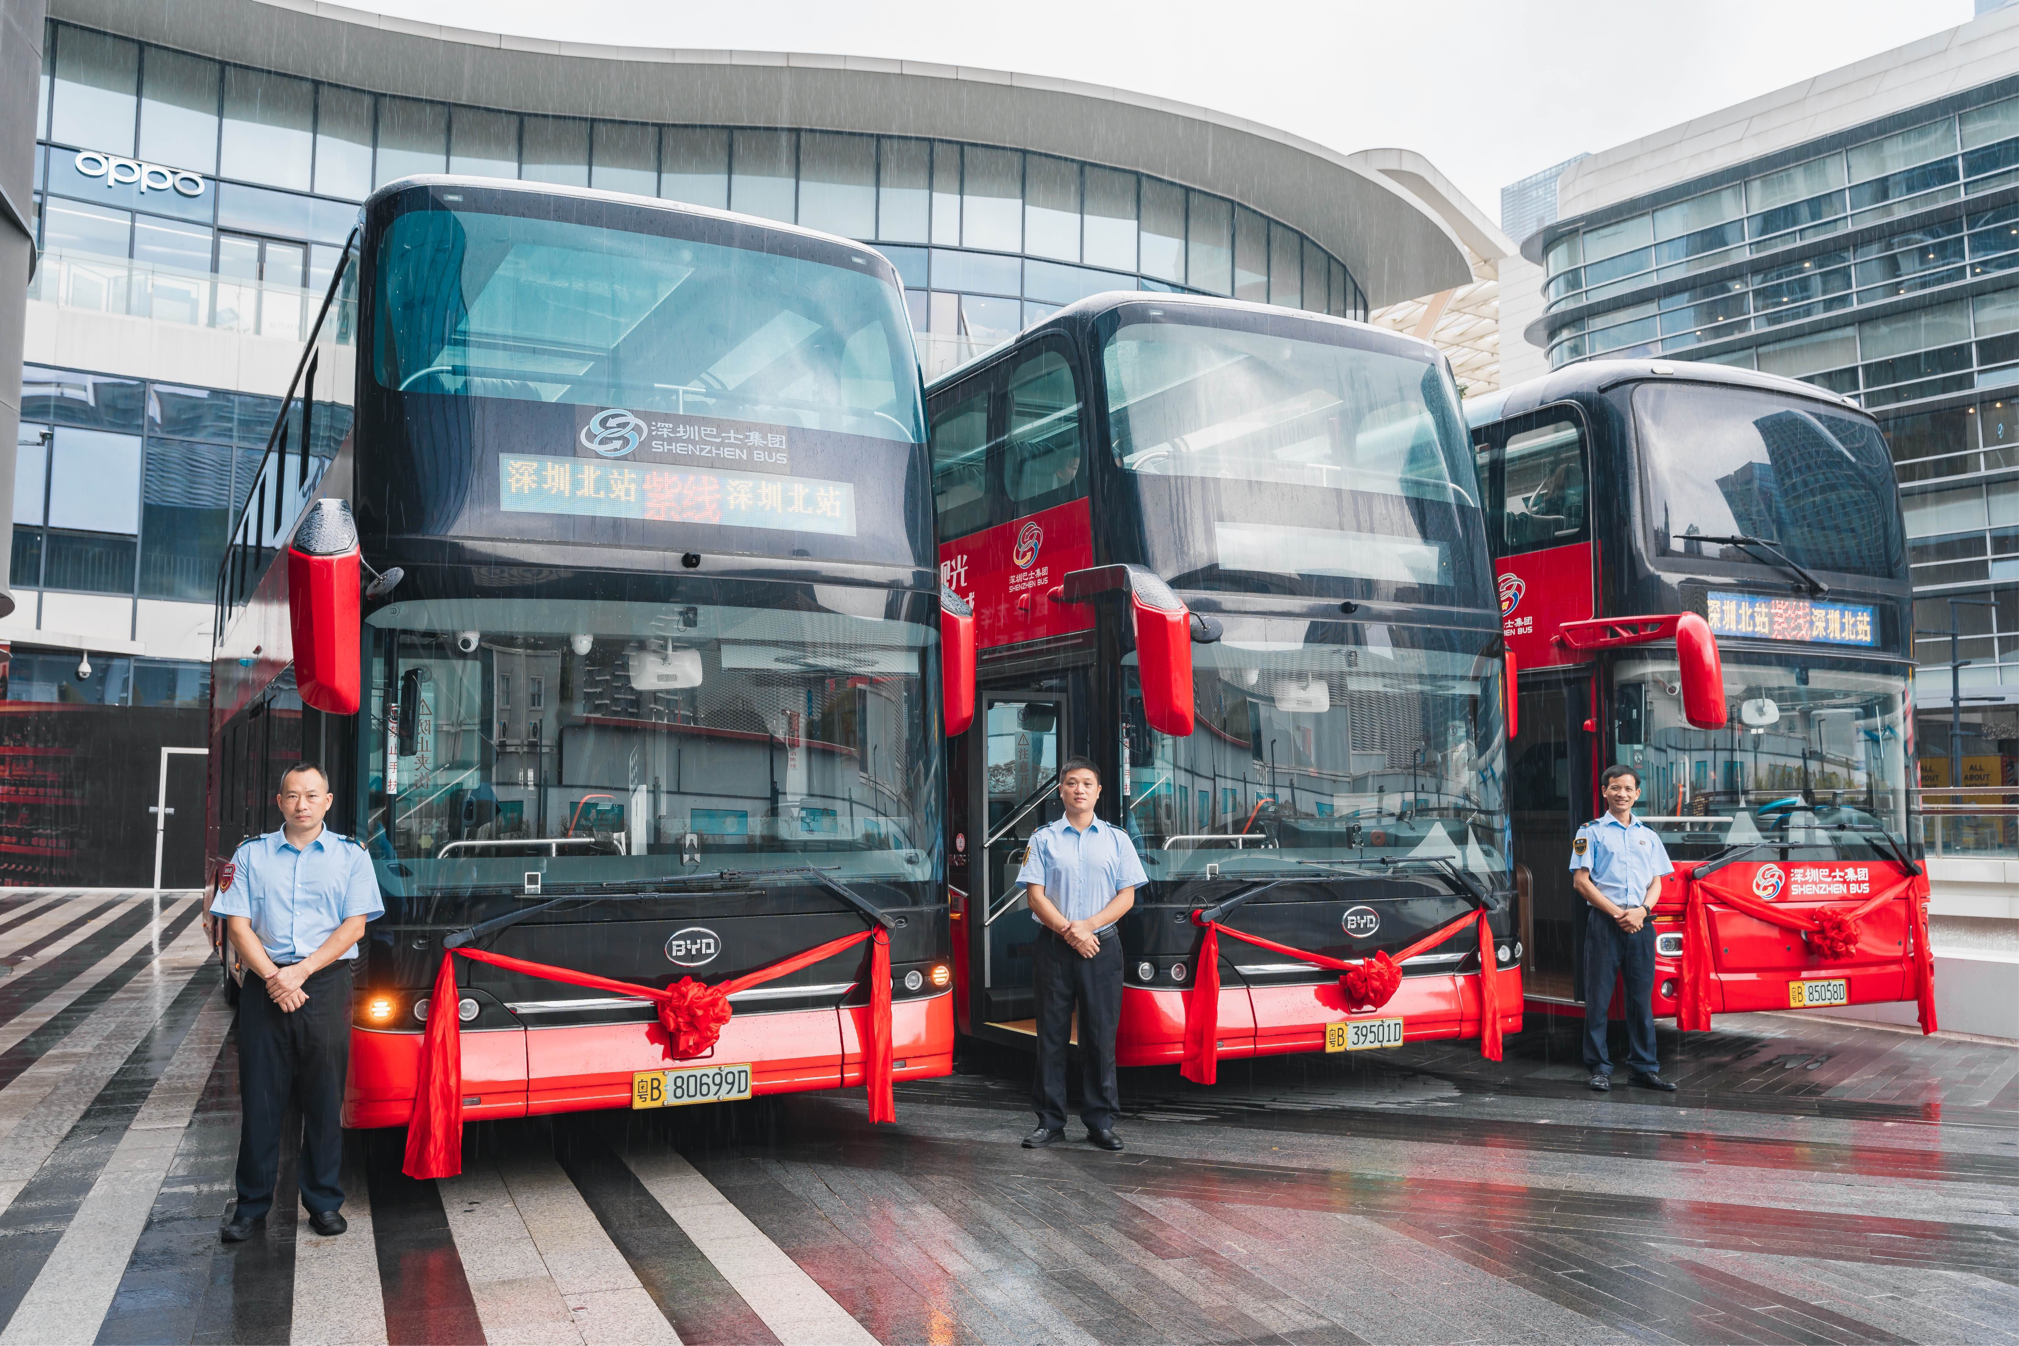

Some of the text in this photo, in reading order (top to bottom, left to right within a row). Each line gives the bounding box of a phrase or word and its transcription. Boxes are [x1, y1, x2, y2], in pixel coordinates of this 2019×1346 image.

[75, 151, 206, 195] oppo
[651, 421, 786, 449] 深圳巴士集团
[652, 440, 788, 464] SHENZHEN BUS
[507, 460, 842, 522] 深圳北站 紫线 深圳北站
[1009, 566, 1048, 584] 深圳巴士集团
[1009, 577, 1048, 593] SHENZHEN BUS
[1503, 616, 1532, 628] 士集团
[1708, 599, 1769, 634] 深圳北站
[1811, 607, 1871, 642] 深圳北站
[1518, 626, 1532, 635] BUS
[1790, 867, 1869, 883] 深圳巴士集团
[1791, 883, 1870, 895] SHENZHEN BUS
[1347, 915, 1376, 929] BYD
[672, 938, 715, 957] BYD
[1808, 983, 1845, 1002] 85058D
[1352, 1022, 1402, 1046] 39501D
[673, 1069, 749, 1100] 80699D
